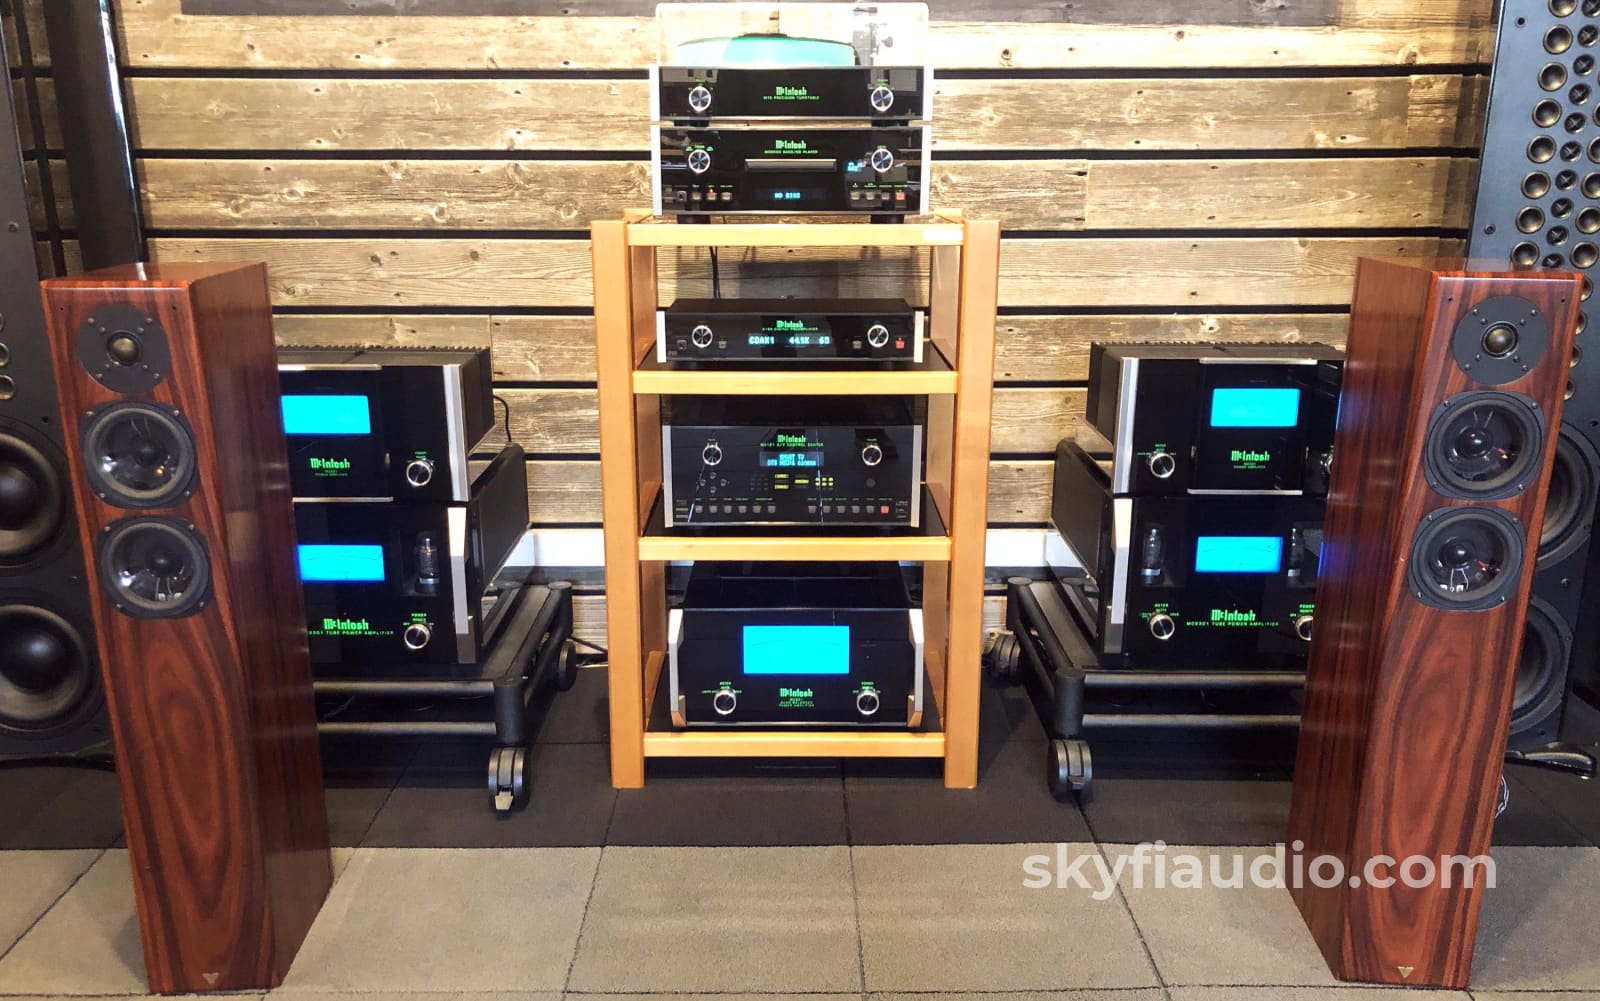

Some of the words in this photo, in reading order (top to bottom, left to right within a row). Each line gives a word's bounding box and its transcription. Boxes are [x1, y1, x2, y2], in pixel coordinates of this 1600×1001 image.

[775, 86, 807, 96] McIntosh
[775, 139, 807, 149] McIntosh
[1231, 450, 1270, 462] McIntosh
[310, 457, 350, 469] McIntosh
[1210, 609, 1256, 621] McIntosh
[323, 618, 369, 630] McIntosh
[780, 688, 813, 697] McIntosh
